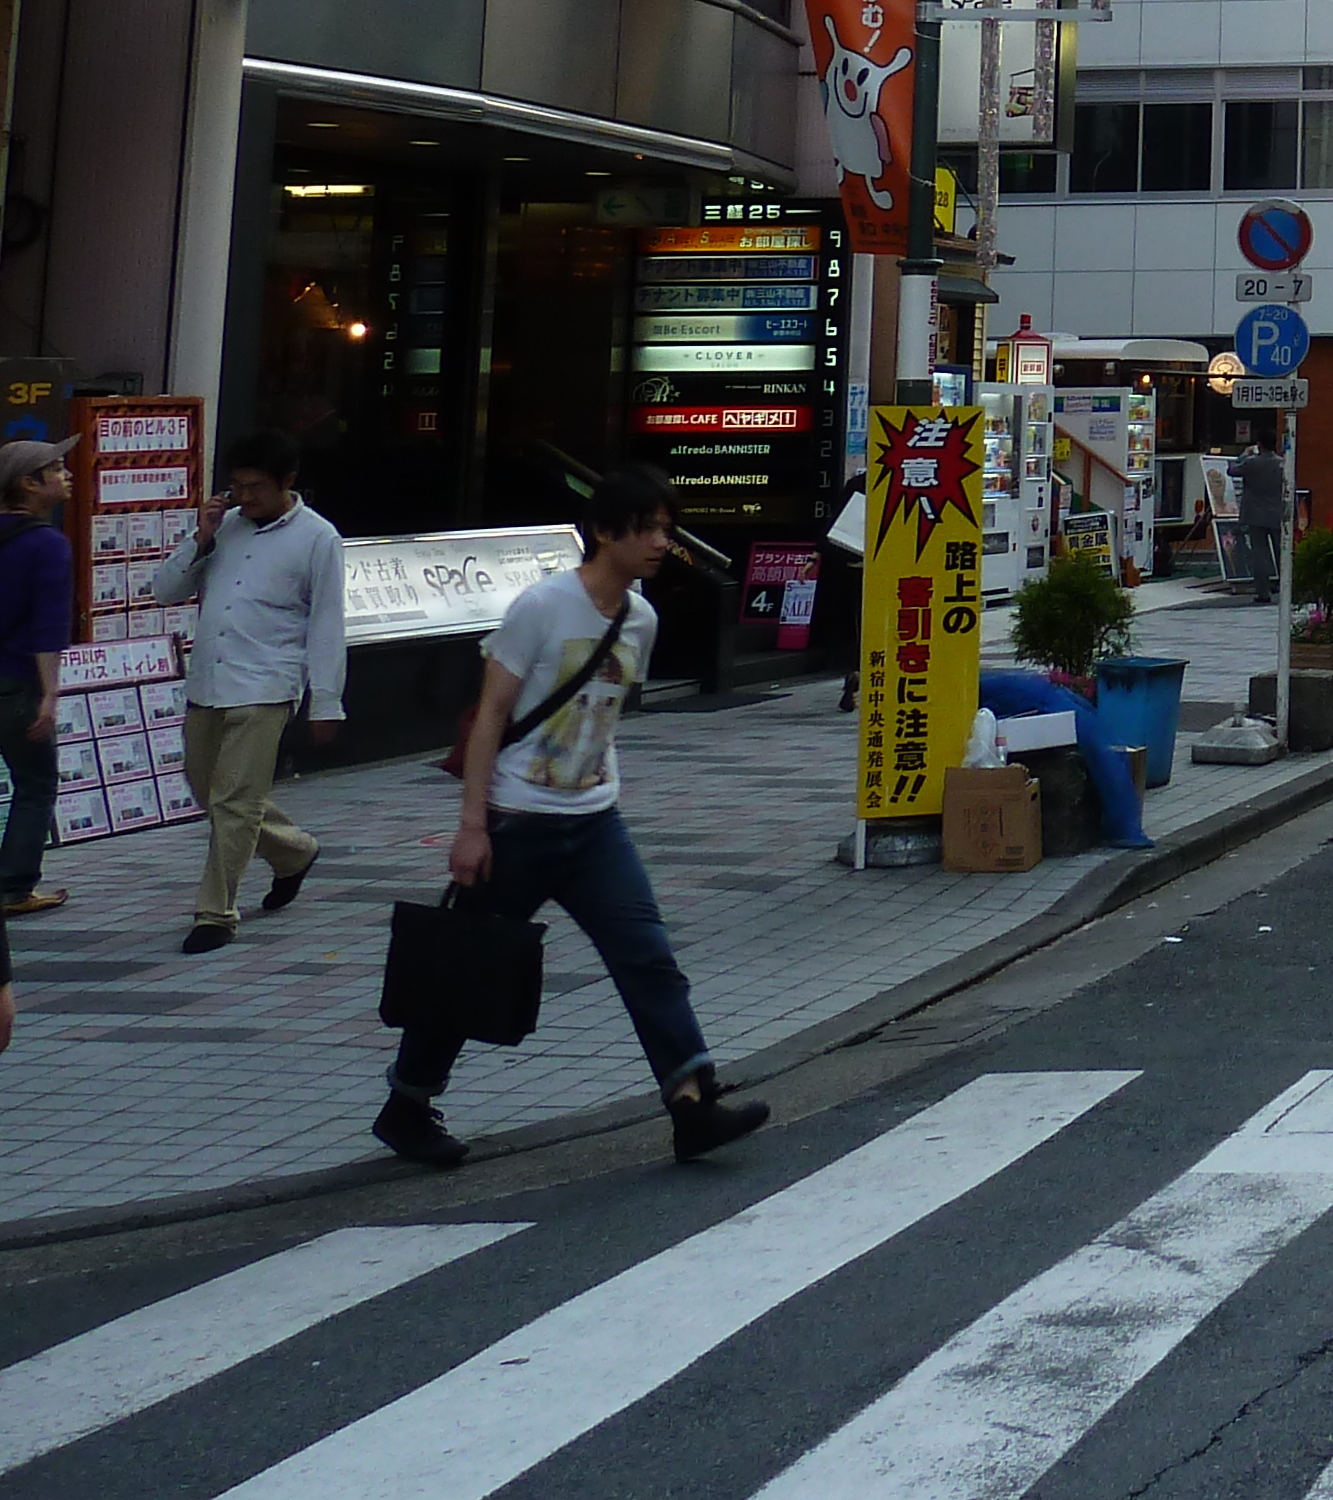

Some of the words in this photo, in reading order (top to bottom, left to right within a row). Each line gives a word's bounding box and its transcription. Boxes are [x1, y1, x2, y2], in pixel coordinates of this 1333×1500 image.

[830, 231, 842, 248] 9
[828, 259, 840, 278] 8
[827, 288, 840, 307] 7
[1258, 309, 1289, 322] 7-20
[825, 318, 838, 337] 6
[1251, 320, 1280, 366] P
[1270, 346, 1291, 366] 40
[695, 351, 754, 360] CLOVER
[824, 347, 838, 367] 5
[8, 382, 52, 404] 3F
[763, 383, 808, 394] RINKAN
[823, 379, 836, 396] 4
[690, 414, 719, 425] CAFE
[821, 409, 834, 427] 3
[1067, 530, 1110, 550] 貴金属
[942, 540, 979, 635] 路上の
[751, 591, 774, 614] 4F
[866, 650, 886, 810] 新宿中央通発展会
